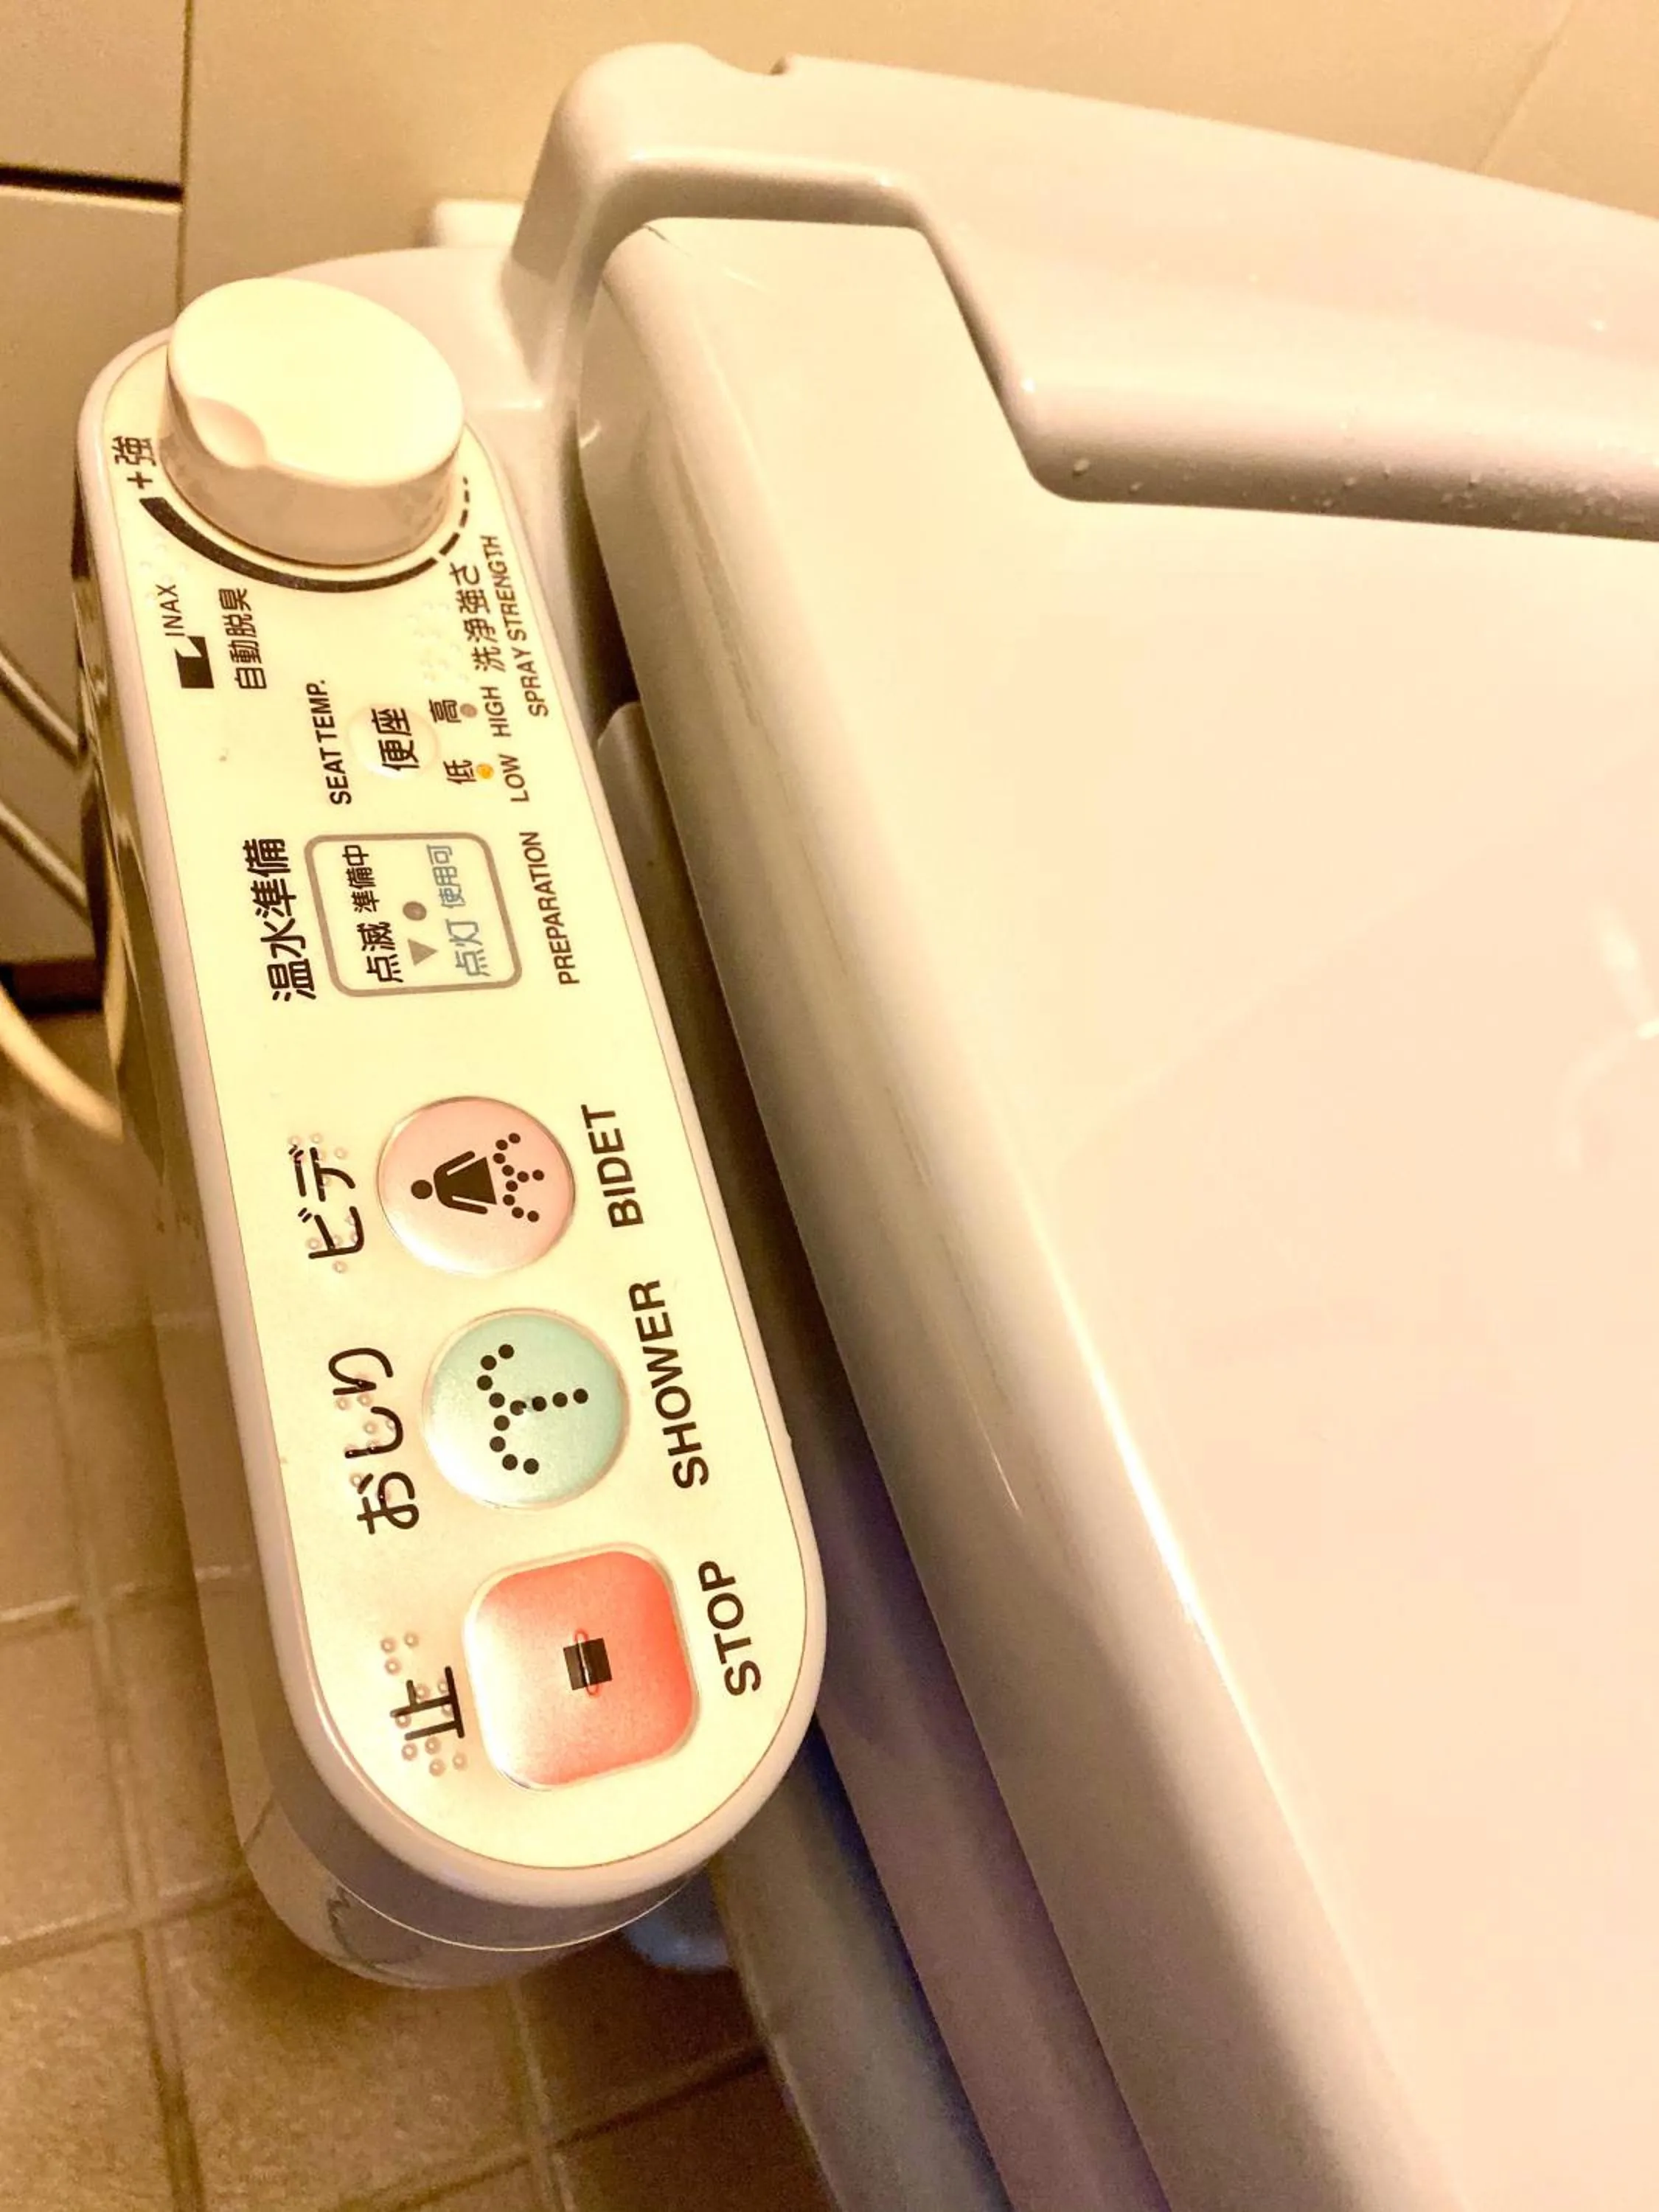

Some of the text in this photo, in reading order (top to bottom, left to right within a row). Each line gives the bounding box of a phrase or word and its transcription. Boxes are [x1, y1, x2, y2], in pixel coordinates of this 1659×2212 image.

[156, 583, 185, 637] INAX
[218, 587, 267, 691] 自動脱臭
[450, 561, 507, 673] 洗浄強さ
[479, 535, 549, 717] SPRAY STRENGTH
[305, 678, 352, 804] SEAT TEMP.
[371, 707, 420, 772] 便座
[428, 698, 462, 724] 高
[480, 686, 512, 738] HIGH
[443, 759, 477, 785] 低
[498, 754, 530, 803] LOW
[242, 838, 317, 1003] 温水準備
[342, 844, 404, 984] 点滅 準備中
[426, 844, 491, 978] 点灯 使用可
[519, 831, 581, 985] PREPARATION
[289, 1143, 365, 1259] ビデ
[580, 1104, 644, 1228] BIDET
[328, 1346, 420, 1535] おしり
[627, 1279, 709, 1489] SHOWER
[698, 1559, 762, 1697] STOP
[389, 1665, 465, 1741] 止
